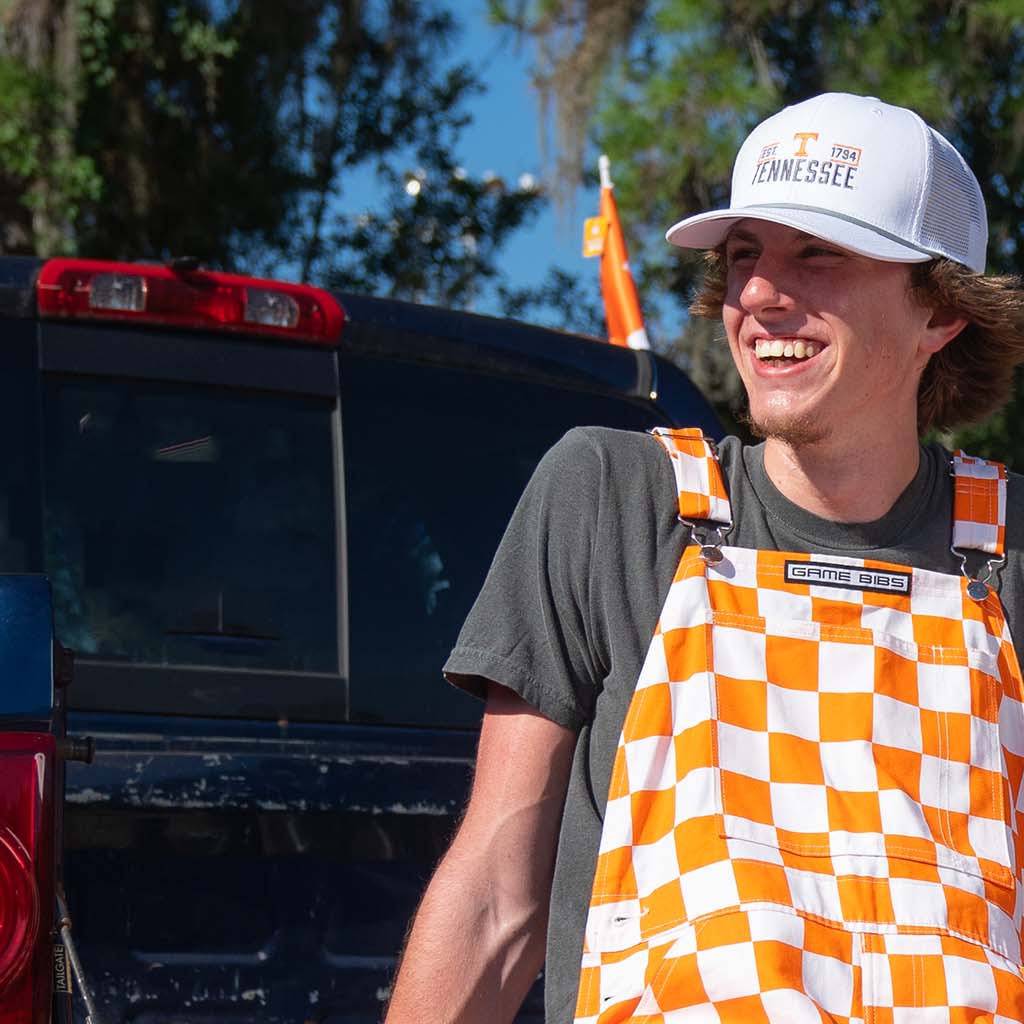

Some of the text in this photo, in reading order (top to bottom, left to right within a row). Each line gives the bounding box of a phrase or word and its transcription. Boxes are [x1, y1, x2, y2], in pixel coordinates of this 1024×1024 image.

[794, 133, 819, 157] T
[831, 147, 857, 162] 1794
[751, 158, 858, 190] TENNESSEE
[792, 567, 904, 588] GAME BIBS
[55, 946, 66, 990] TAILGATE
